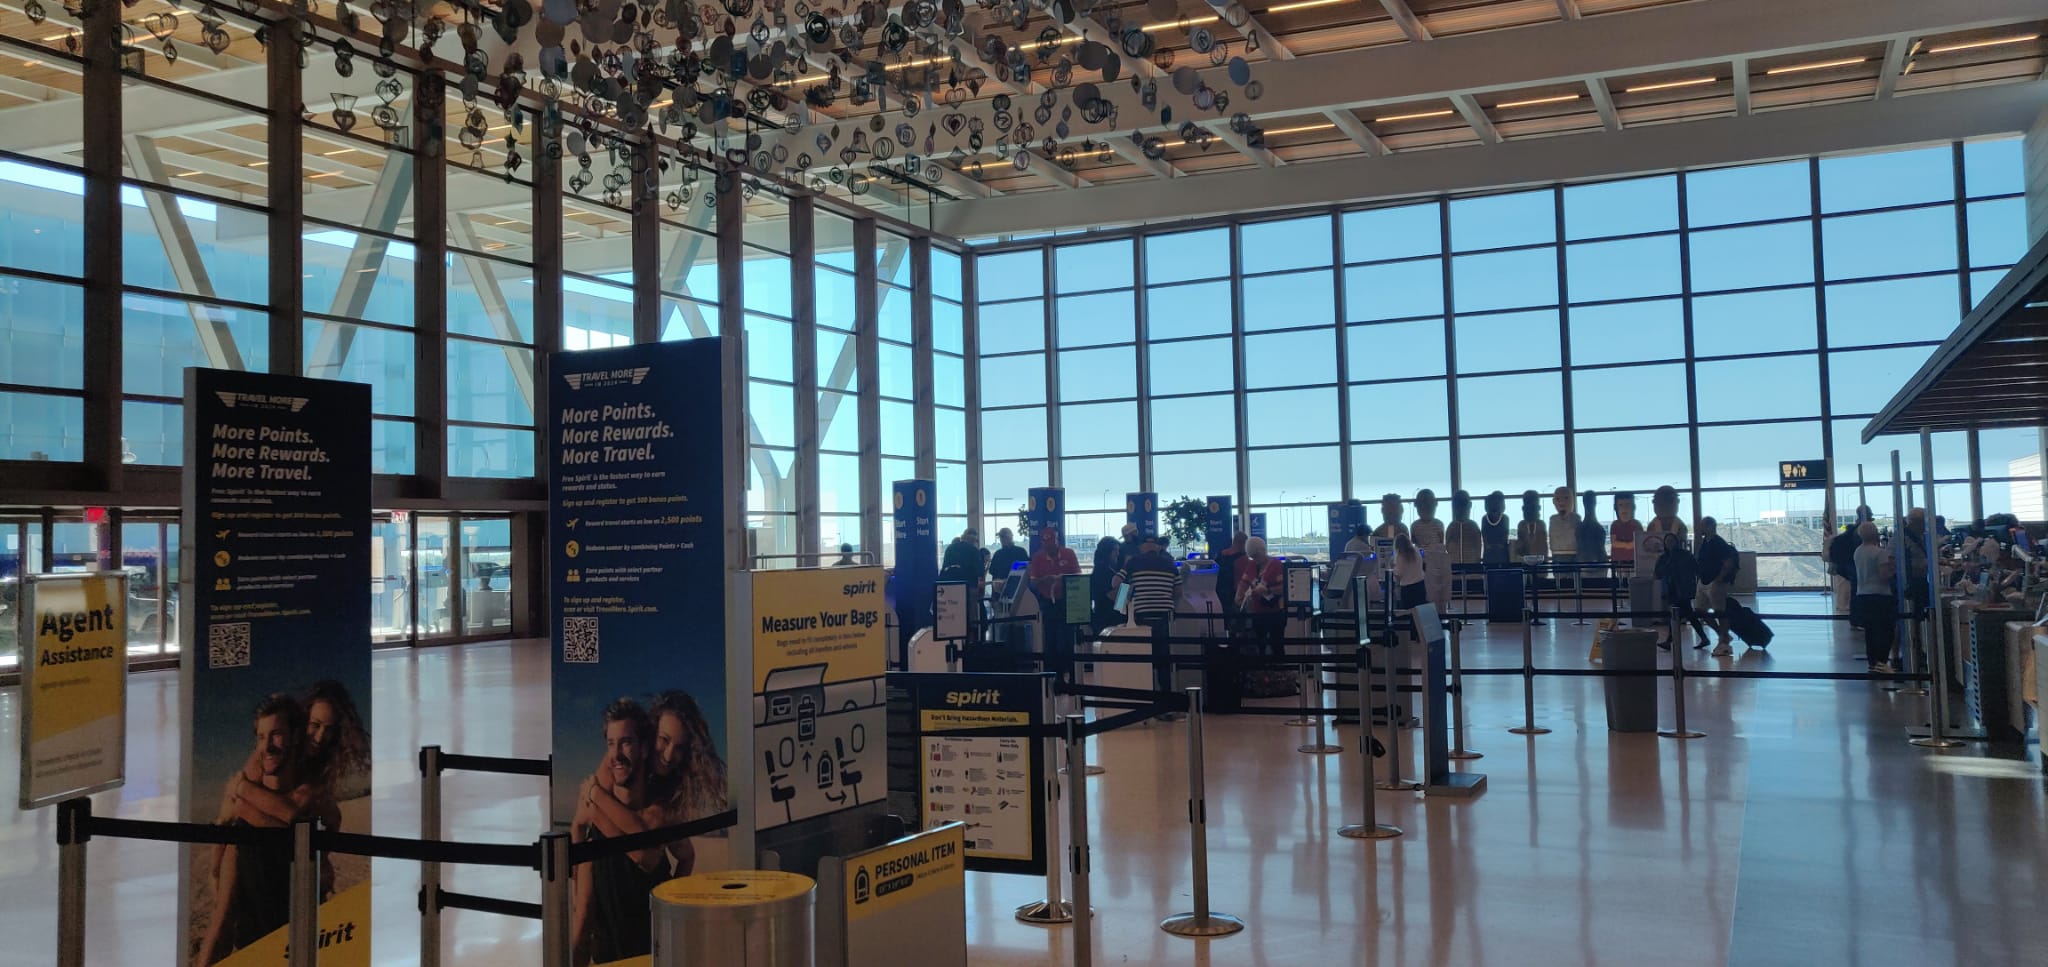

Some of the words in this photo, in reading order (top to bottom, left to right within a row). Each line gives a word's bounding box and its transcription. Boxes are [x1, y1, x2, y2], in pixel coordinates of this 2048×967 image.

[583, 371, 609, 382] TRAVEL
[611, 368, 633, 378] MORE
[562, 408, 599, 424] More
[602, 402, 656, 421] Points.
[212, 424, 256, 440] More
[259, 426, 313, 443] Points.
[562, 428, 599, 445] More
[602, 421, 674, 442] Rewards.
[212, 443, 256, 460] More
[259, 445, 330, 463] Rewards.
[562, 448, 600, 464] More
[603, 442, 655, 462] Travel.
[211, 462, 256, 479] More
[260, 464, 312, 480] Travel.
[843, 580, 876, 597] spirit
[40, 604, 114, 641] Agent
[762, 615, 817, 634] Measure
[820, 611, 848, 628] Your
[851, 609, 878, 628] Bags
[41, 645, 113, 667] Assistance
[945, 689, 1001, 707] spirit
[875, 850, 930, 880] PERSONAL
[930, 841, 955, 862] ITEM
